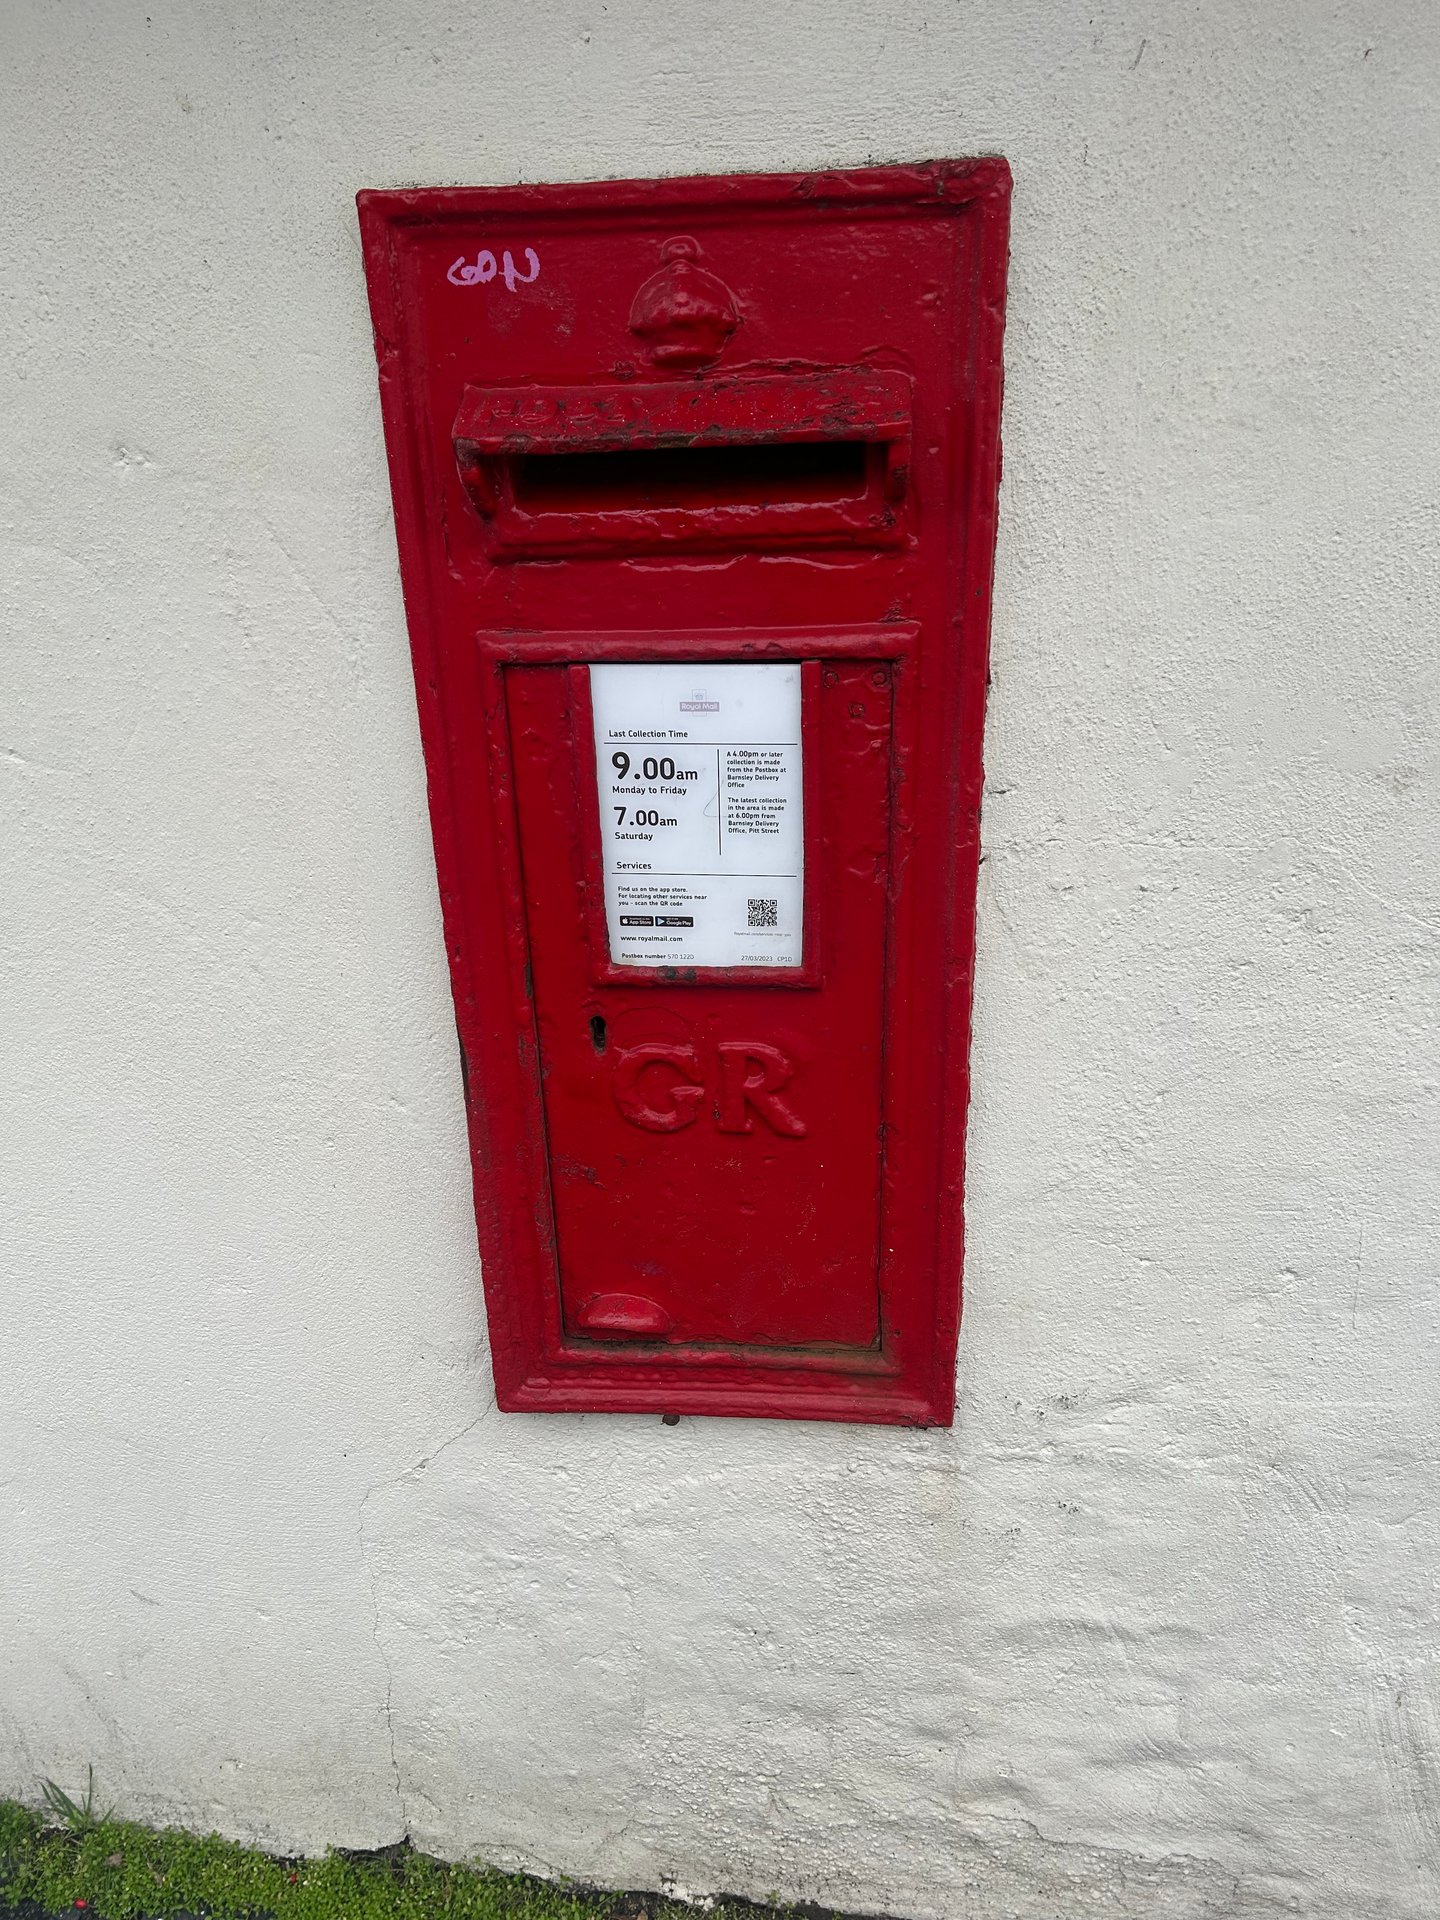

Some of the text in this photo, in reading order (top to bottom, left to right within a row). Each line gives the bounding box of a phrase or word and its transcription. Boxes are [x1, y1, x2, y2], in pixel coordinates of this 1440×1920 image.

[608, 730, 626, 738] Last
[628, 730, 666, 738] Collection
[612, 751, 698, 780] 9.00am
[612, 786, 646, 795] Monday
[660, 786, 687, 796] Friday
[613, 807, 678, 826] 7.00am
[615, 832, 653, 842] Saturday
[616, 862, 652, 870] Services
[612, 1041, 808, 1137] GR
